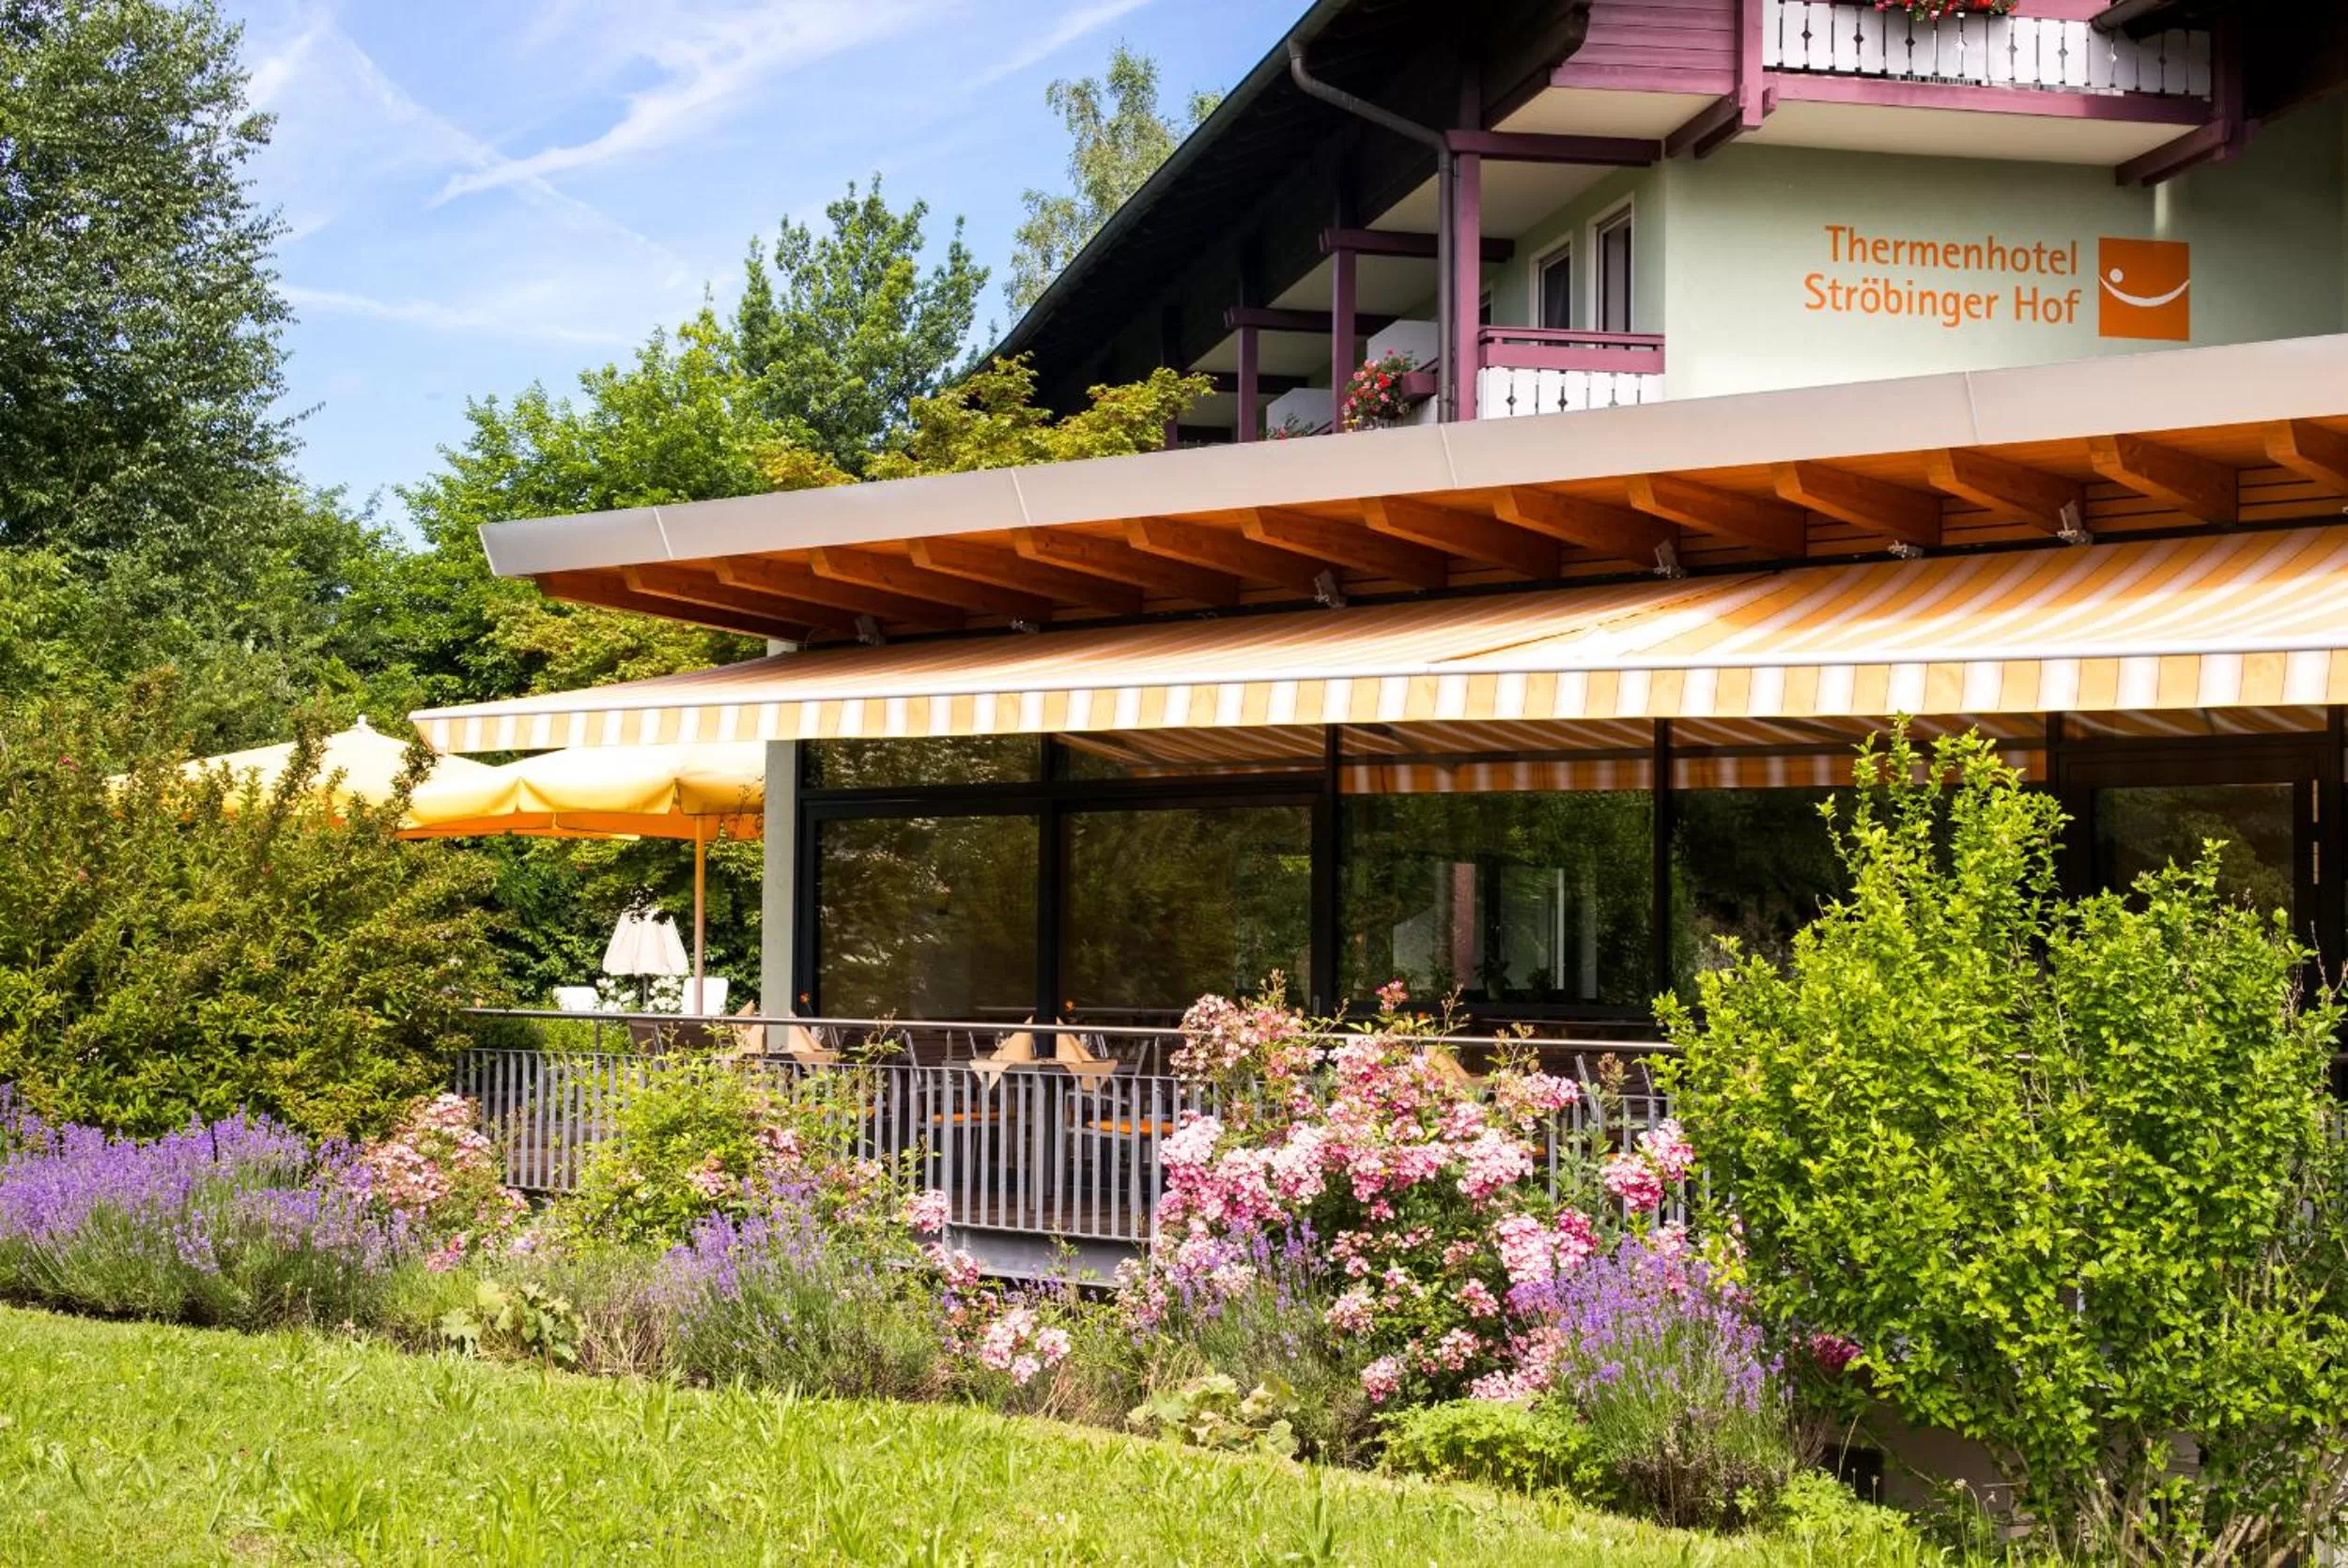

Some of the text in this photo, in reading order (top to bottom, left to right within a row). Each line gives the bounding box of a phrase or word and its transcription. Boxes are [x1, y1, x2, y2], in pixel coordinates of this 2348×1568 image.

[1824, 224, 2078, 278] Thermenhotel
[1802, 272, 2081, 328] Ströbinger Hof
